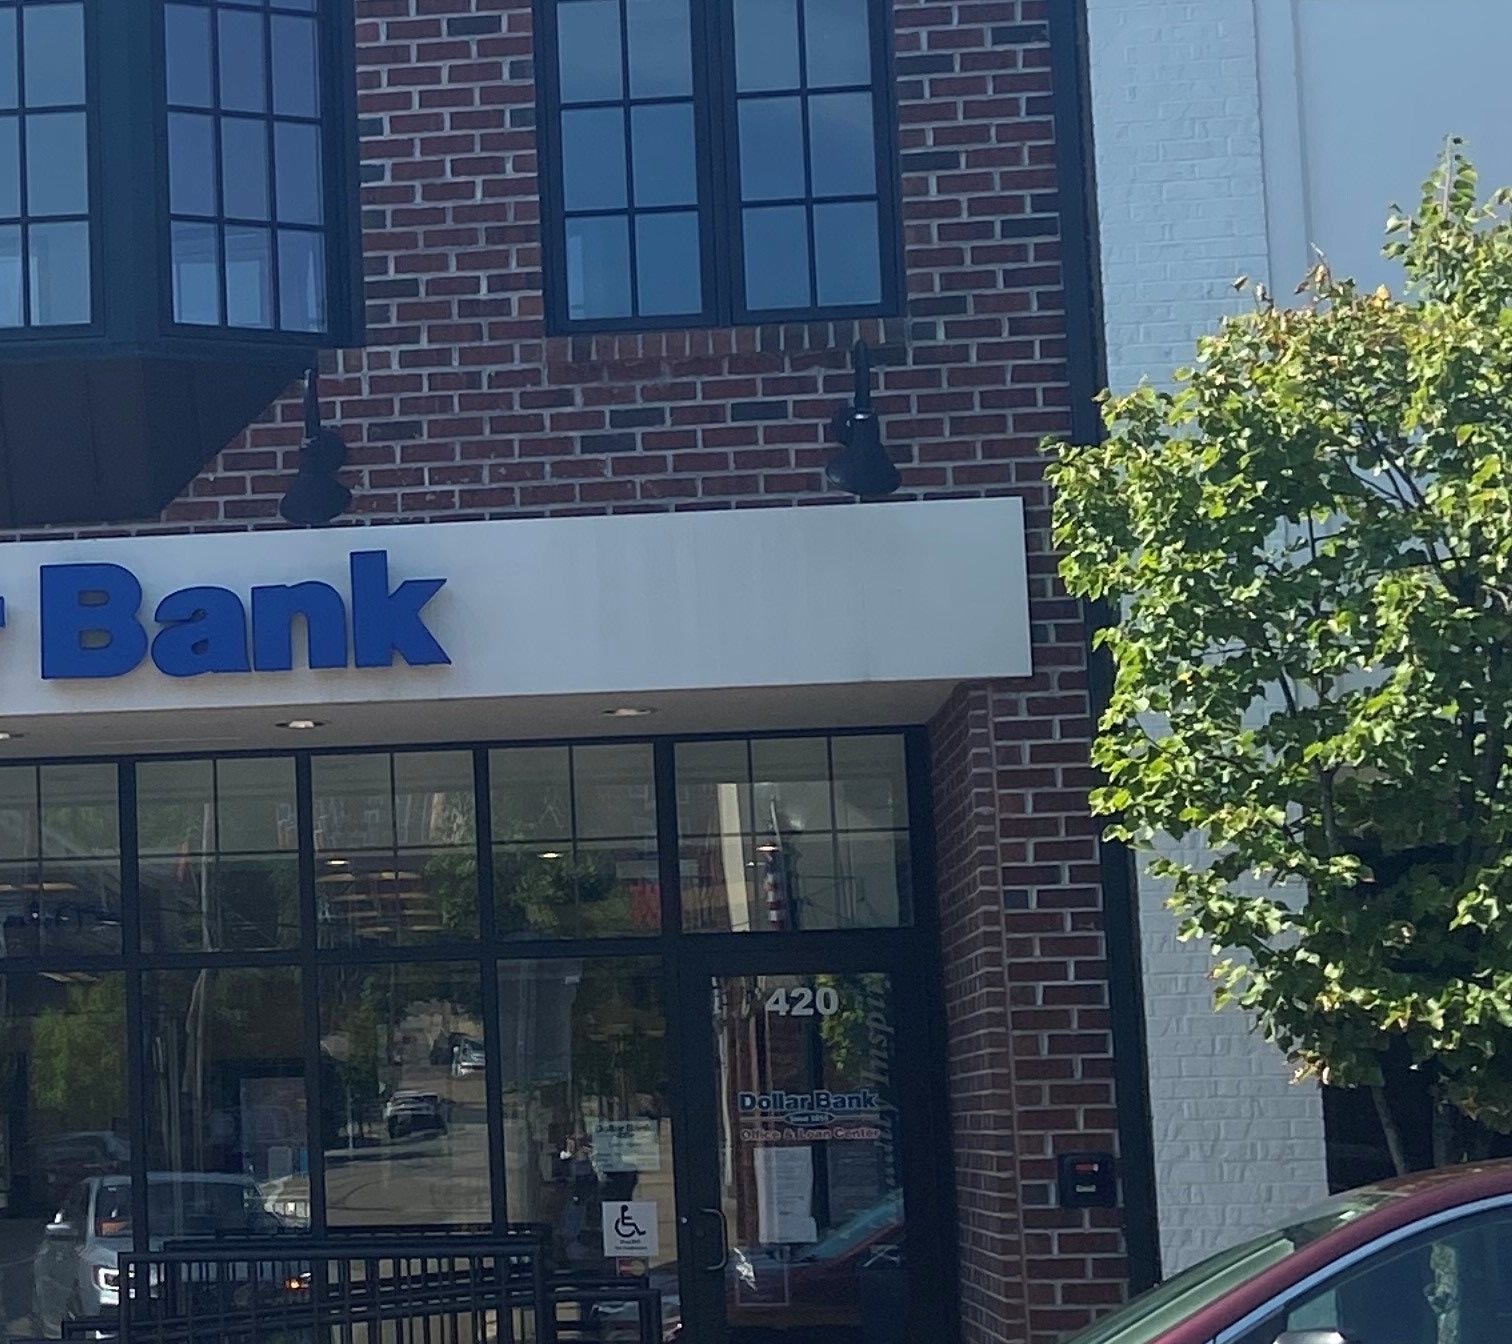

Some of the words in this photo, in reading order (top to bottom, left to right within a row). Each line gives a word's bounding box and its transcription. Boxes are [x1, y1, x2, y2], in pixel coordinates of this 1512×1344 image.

[39, 549, 453, 680] Bank
[764, 986, 839, 1017] 420
[738, 1090, 813, 1112] Dollar
[812, 1088, 880, 1110] Bank
[740, 1128, 781, 1141] Office
[796, 1128, 833, 1140] Loan
[833, 1127, 881, 1140] Center
